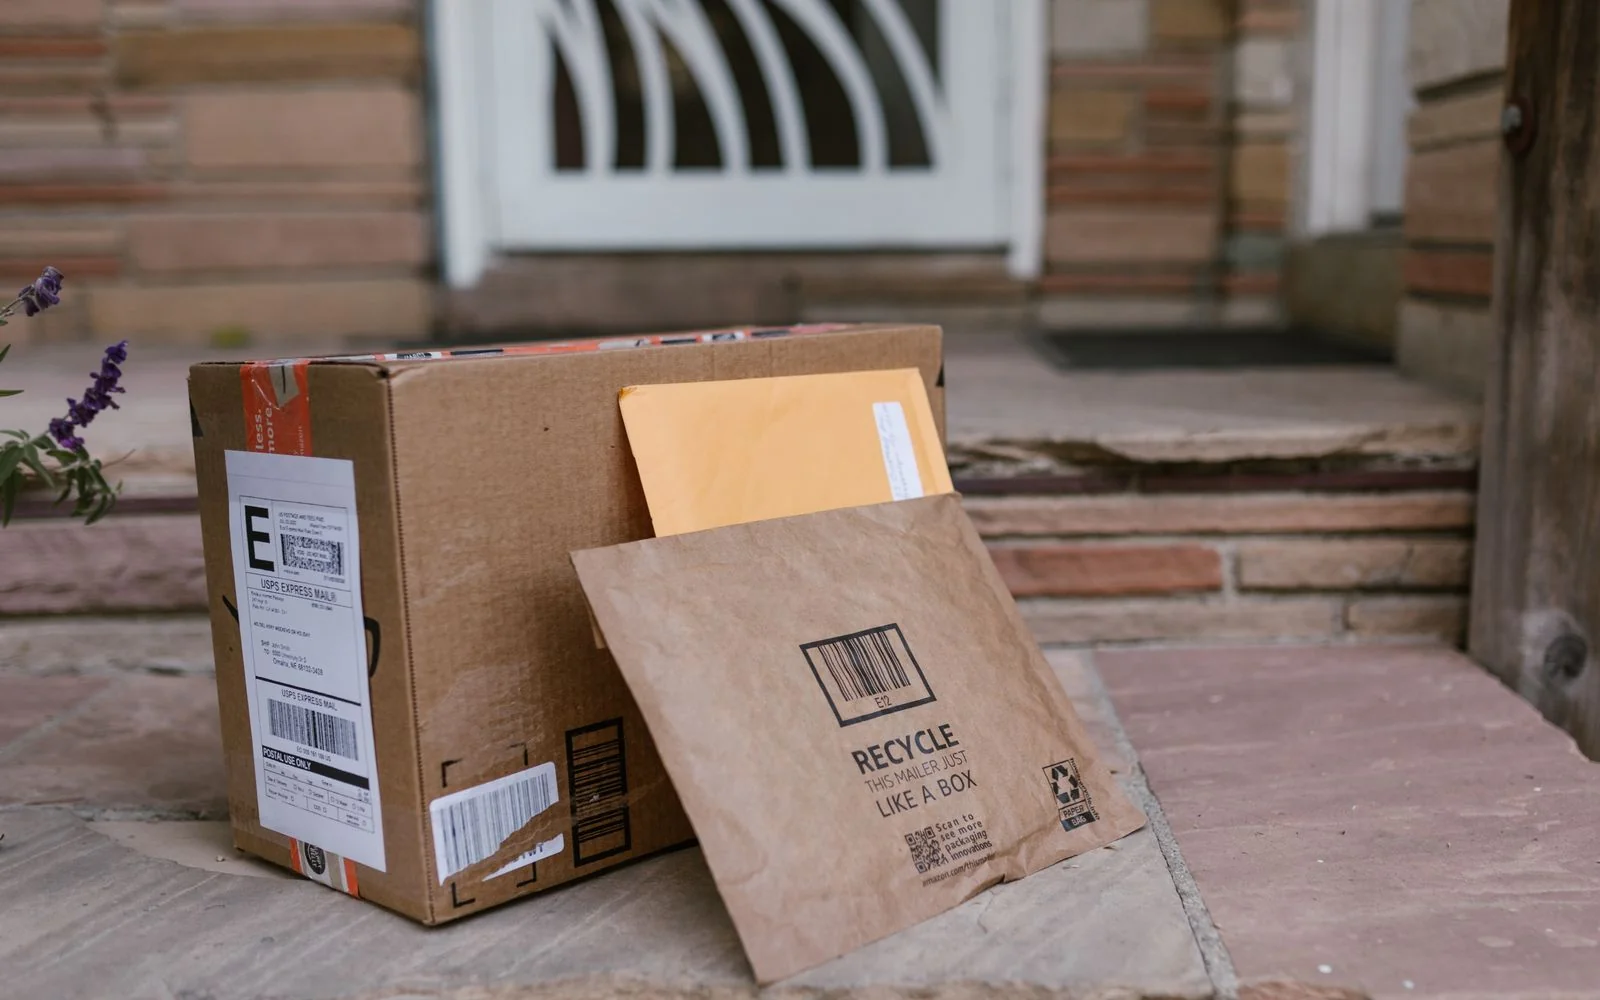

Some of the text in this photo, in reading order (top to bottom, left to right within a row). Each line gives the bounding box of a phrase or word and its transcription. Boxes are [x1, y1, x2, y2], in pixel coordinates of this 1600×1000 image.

[245, 505, 275, 572] E
[261, 579, 279, 591] USPS
[281, 582, 313, 597] EXPRESS
[282, 689, 338, 711] USPS EXPRESS MAIL
[875, 696, 892, 708] E12
[263, 748, 283, 762] POSTAL
[283, 754, 296, 766] USE
[296, 758, 311, 770] ONLY
[852, 724, 959, 775] RECYCLE
[865, 750, 968, 793] THIS MAILER JUST
[876, 770, 977, 818] LIKE A BOX
[1063, 805, 1085, 817] PAPER
[1071, 815, 1086, 826] BAG
[936, 814, 974, 832] Scan to
[941, 821, 982, 841] see more
[945, 830, 987, 855] packaging
